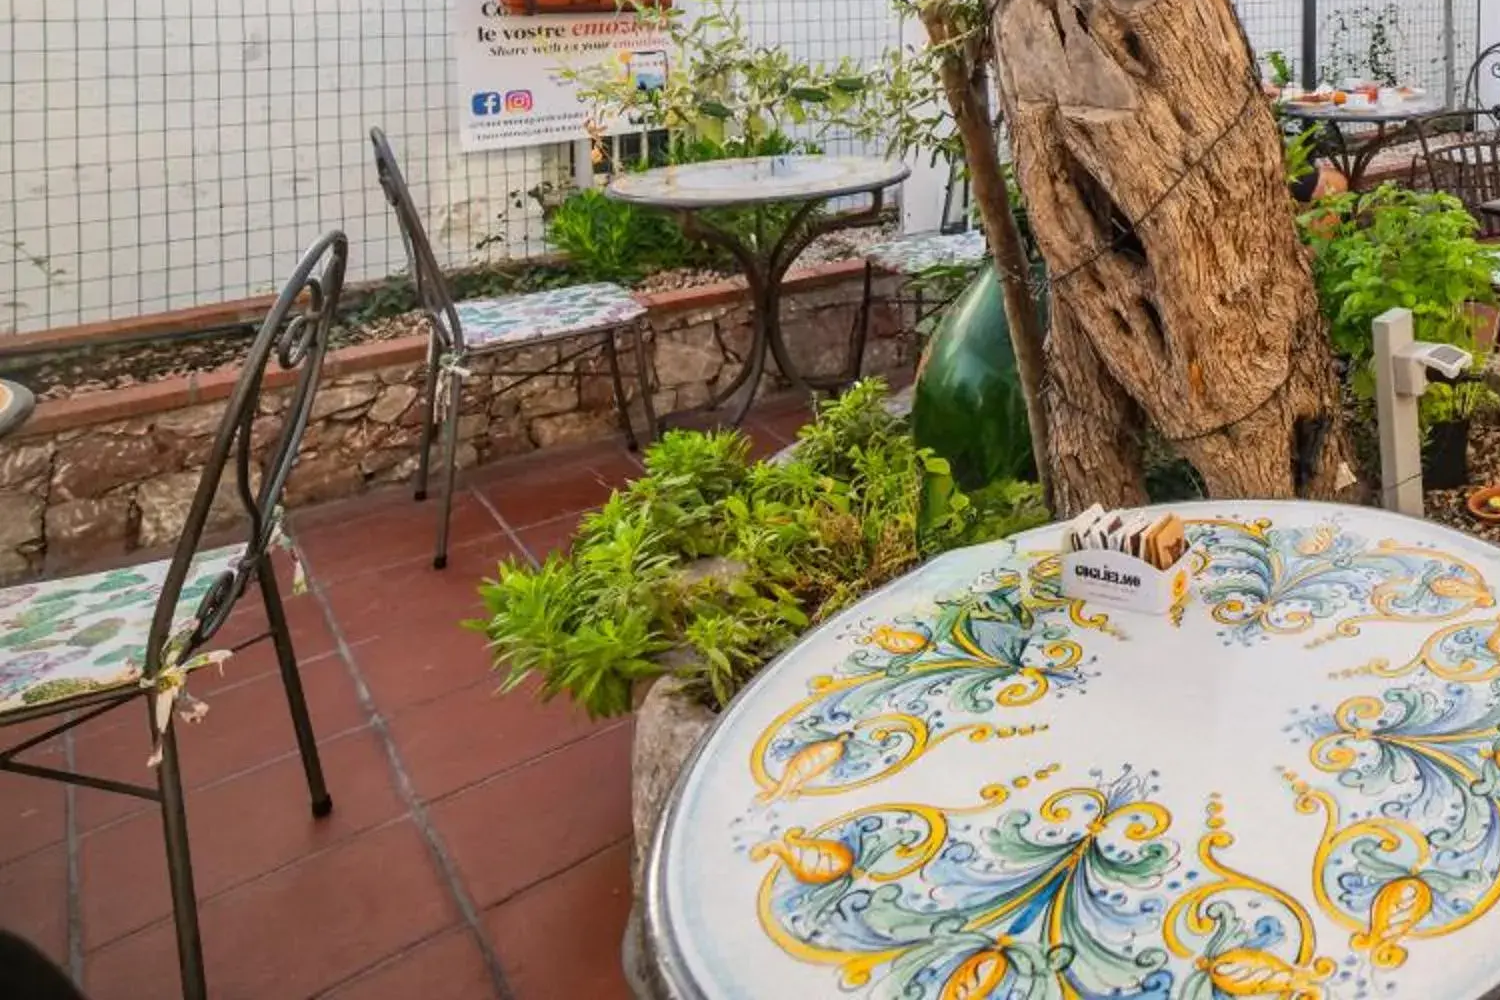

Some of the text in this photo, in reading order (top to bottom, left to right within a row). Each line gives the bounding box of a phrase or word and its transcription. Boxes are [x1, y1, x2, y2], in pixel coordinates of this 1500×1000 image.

[477, 26, 497, 42] le
[503, 23, 566, 41] vostre
[488, 45, 529, 57] Share
[579, 41, 610, 55] your
